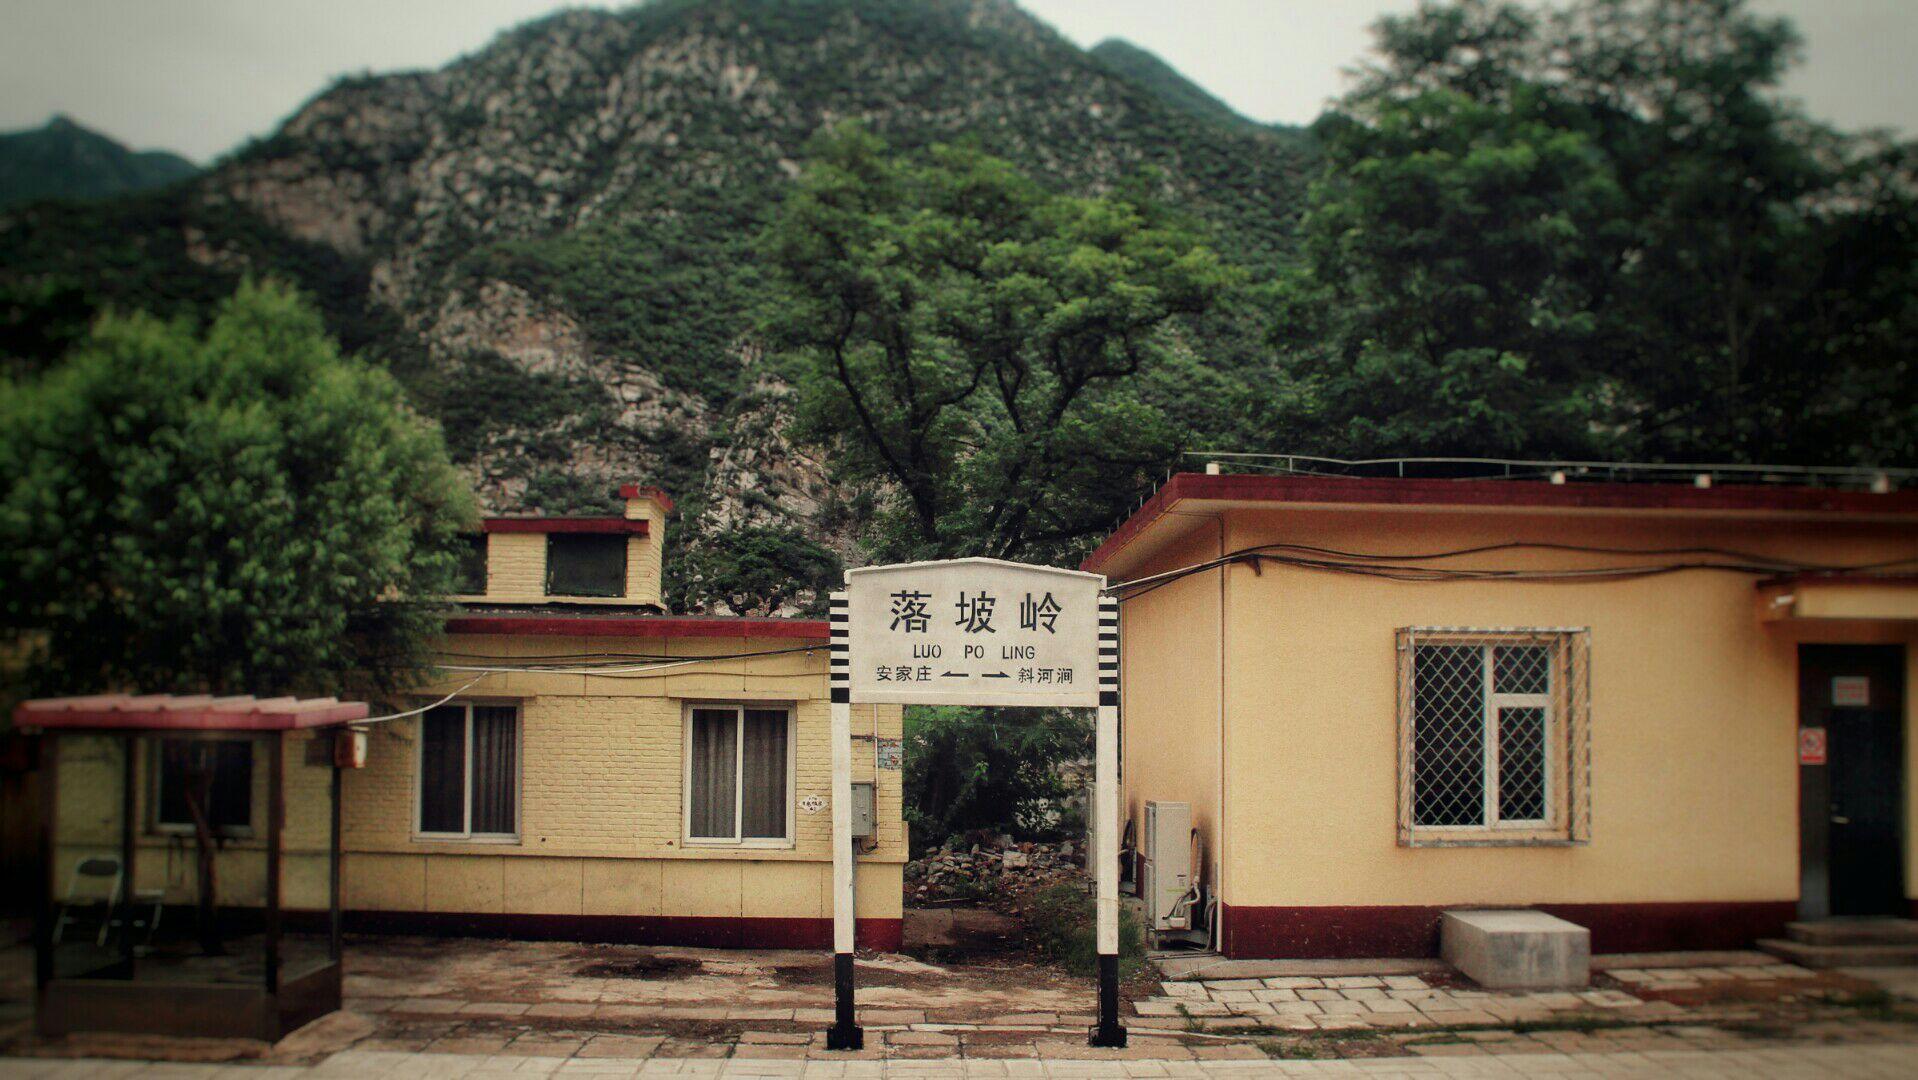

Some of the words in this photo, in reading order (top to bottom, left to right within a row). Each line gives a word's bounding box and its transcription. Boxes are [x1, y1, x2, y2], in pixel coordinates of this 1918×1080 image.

[889, 589, 1063, 635] 落坡岭
[913, 644, 942, 660] LUO
[964, 644, 985, 660] PO
[1002, 645, 1036, 660] LING
[876, 664, 932, 683] 安家庄
[1018, 667, 1074, 685] 斜河涧
